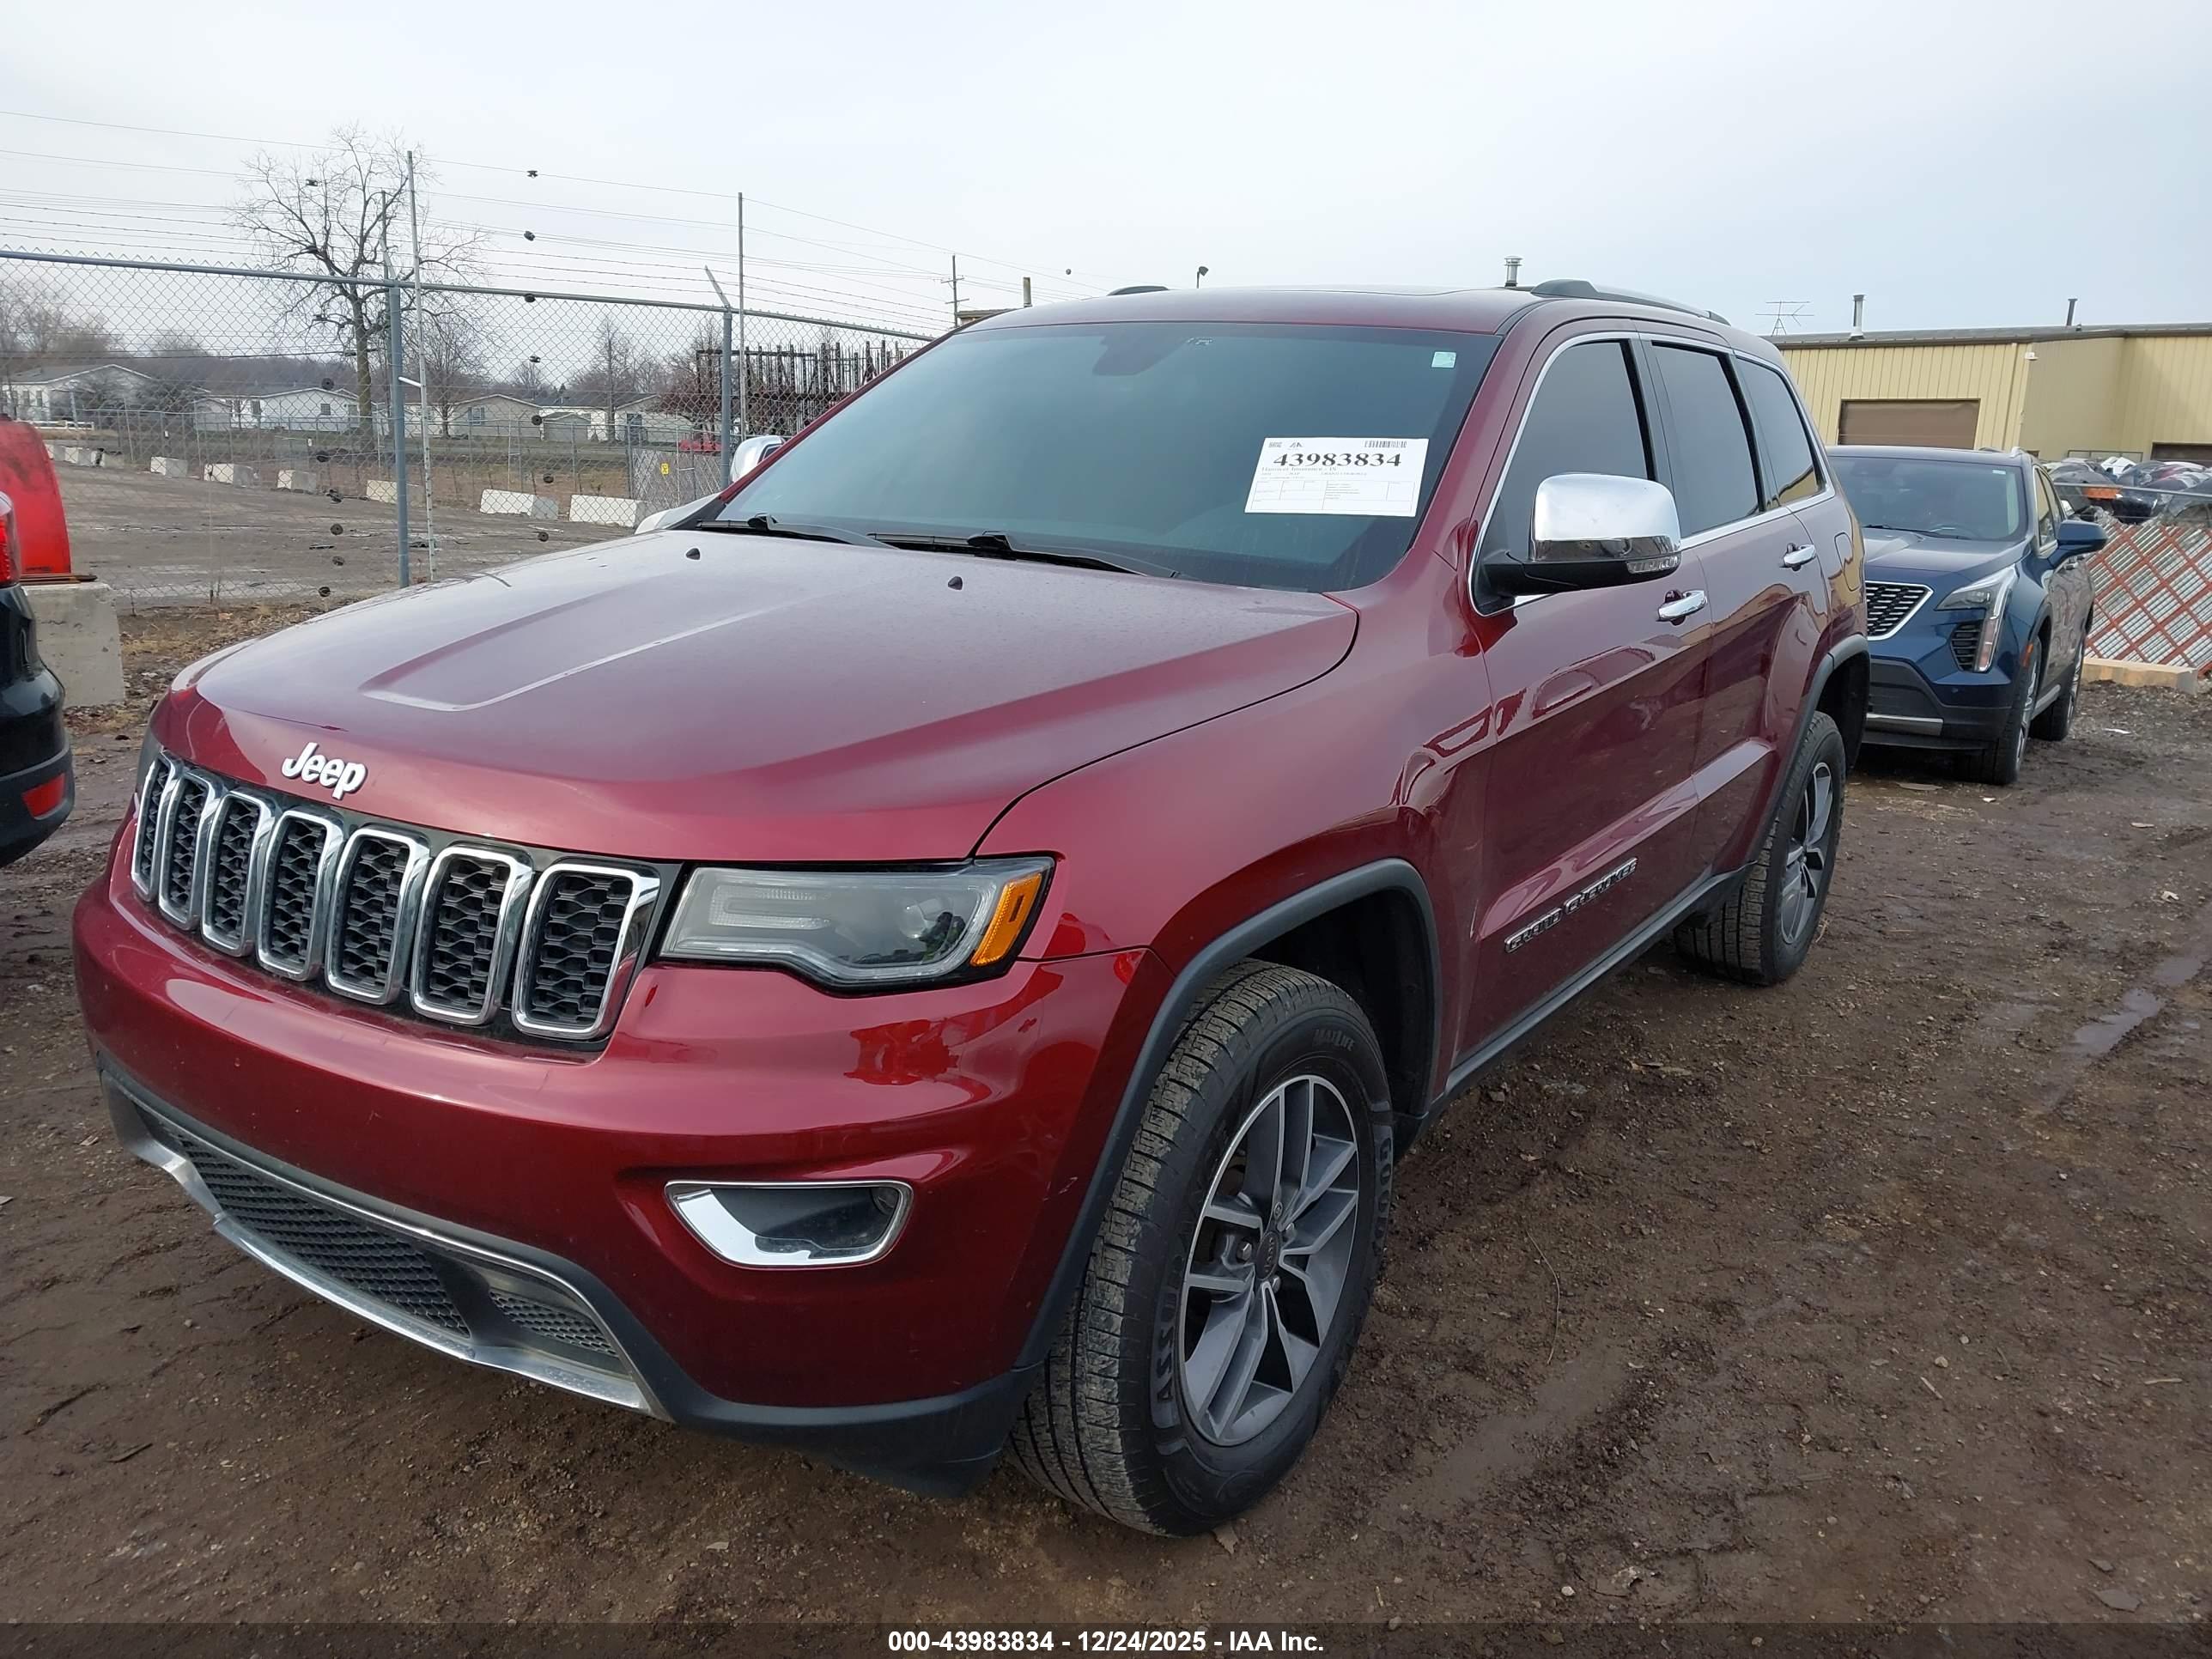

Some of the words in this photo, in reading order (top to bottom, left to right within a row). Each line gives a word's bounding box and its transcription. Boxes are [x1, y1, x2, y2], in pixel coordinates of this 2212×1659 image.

[1273, 453, 1401, 466] 43983834
[281, 741, 368, 801] Jeep
[1504, 907, 1563, 953] GRAND
[1564, 857, 1639, 915] CHEROKEE
